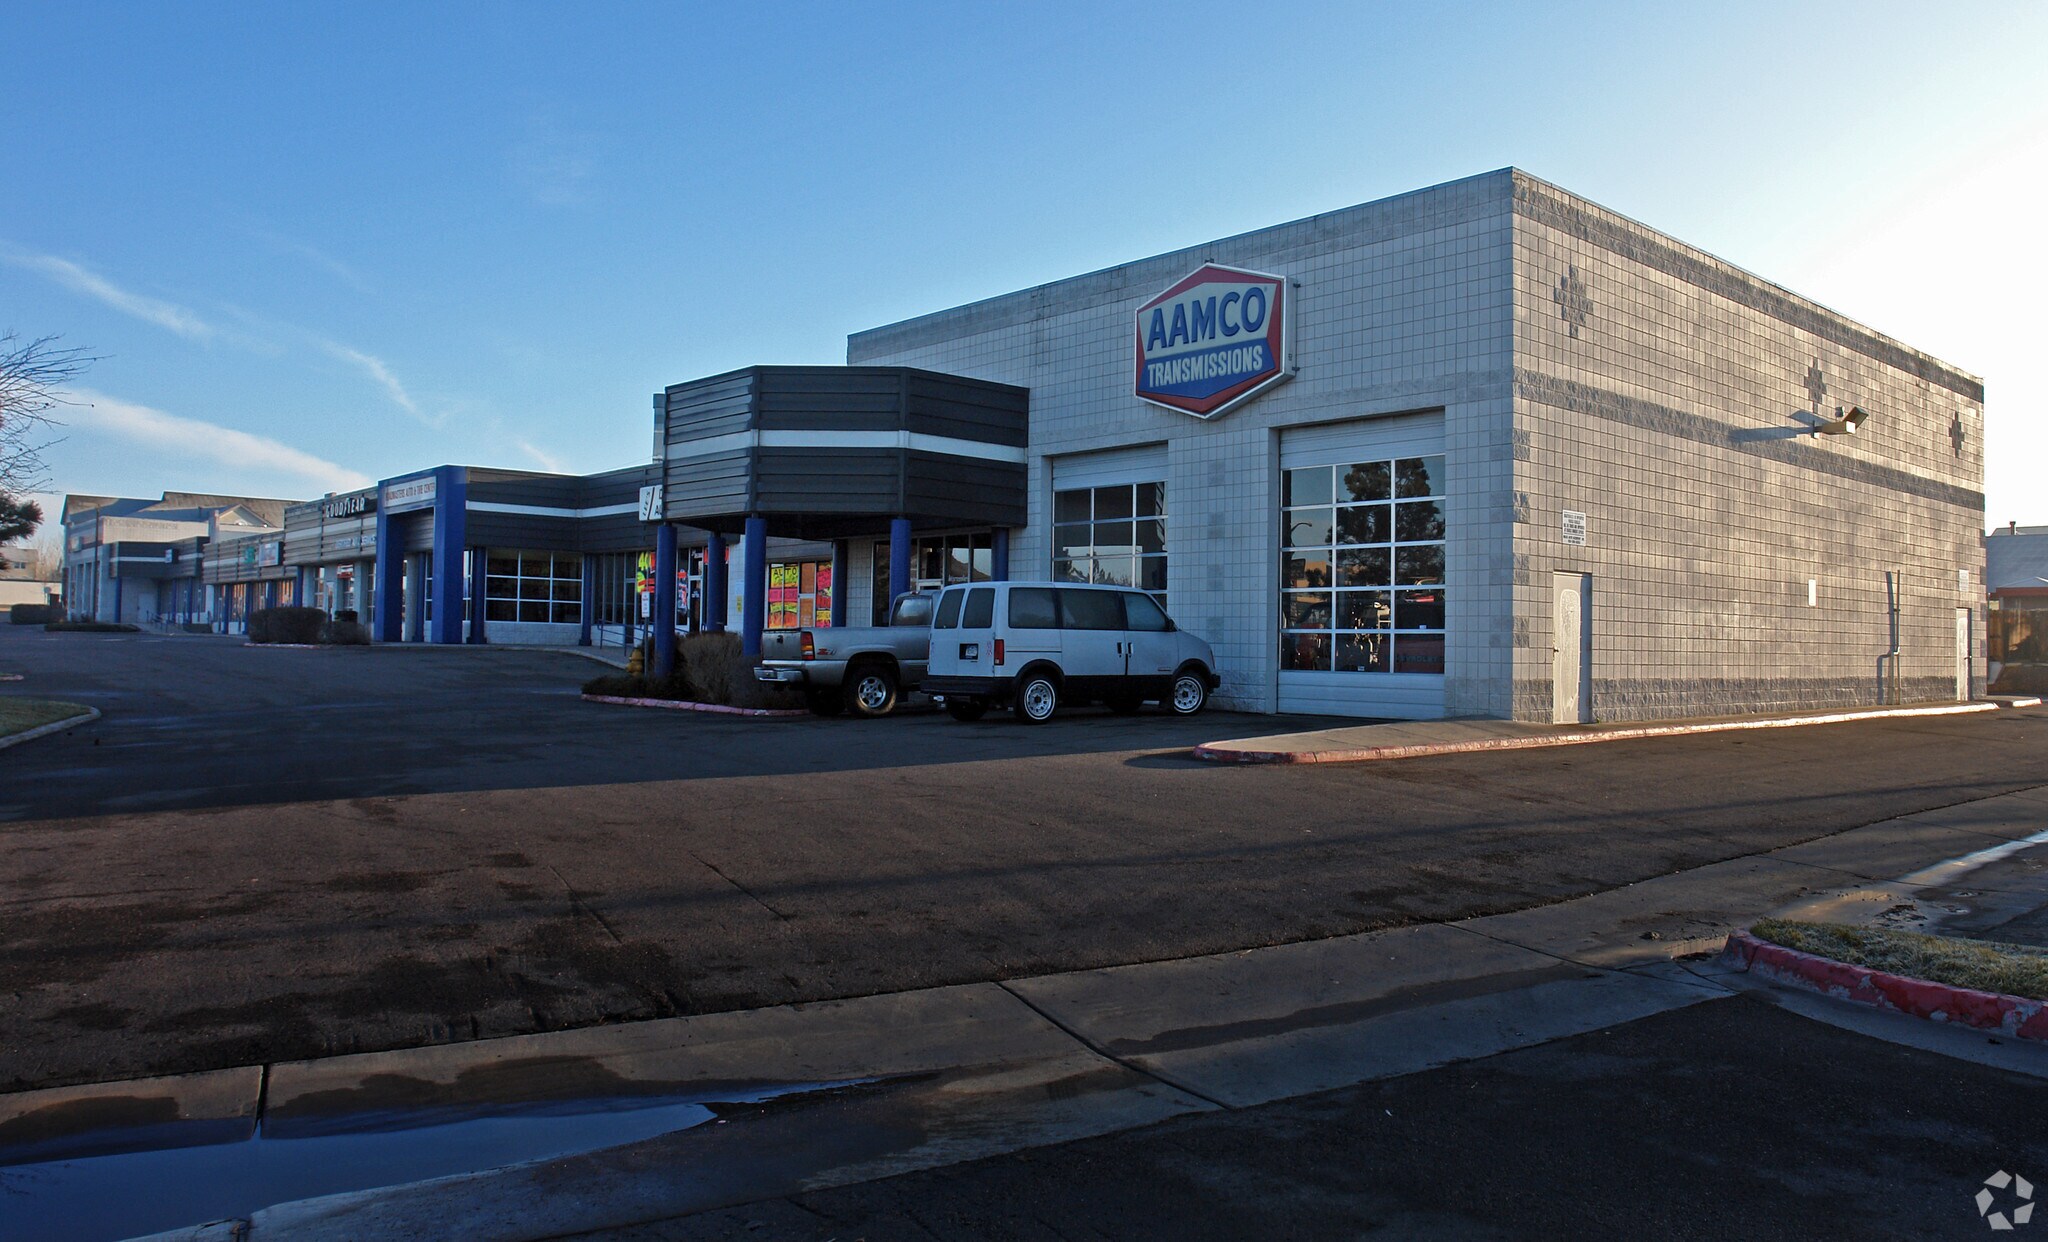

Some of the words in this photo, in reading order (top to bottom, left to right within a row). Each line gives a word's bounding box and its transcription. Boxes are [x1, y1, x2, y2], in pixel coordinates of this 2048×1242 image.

[1147, 286, 1266, 352] AAMCO
[1148, 345, 1263, 388] TRANSMISSIONS
[326, 496, 365, 518] GOODYEAR
[774, 567, 797, 577] AUTO
